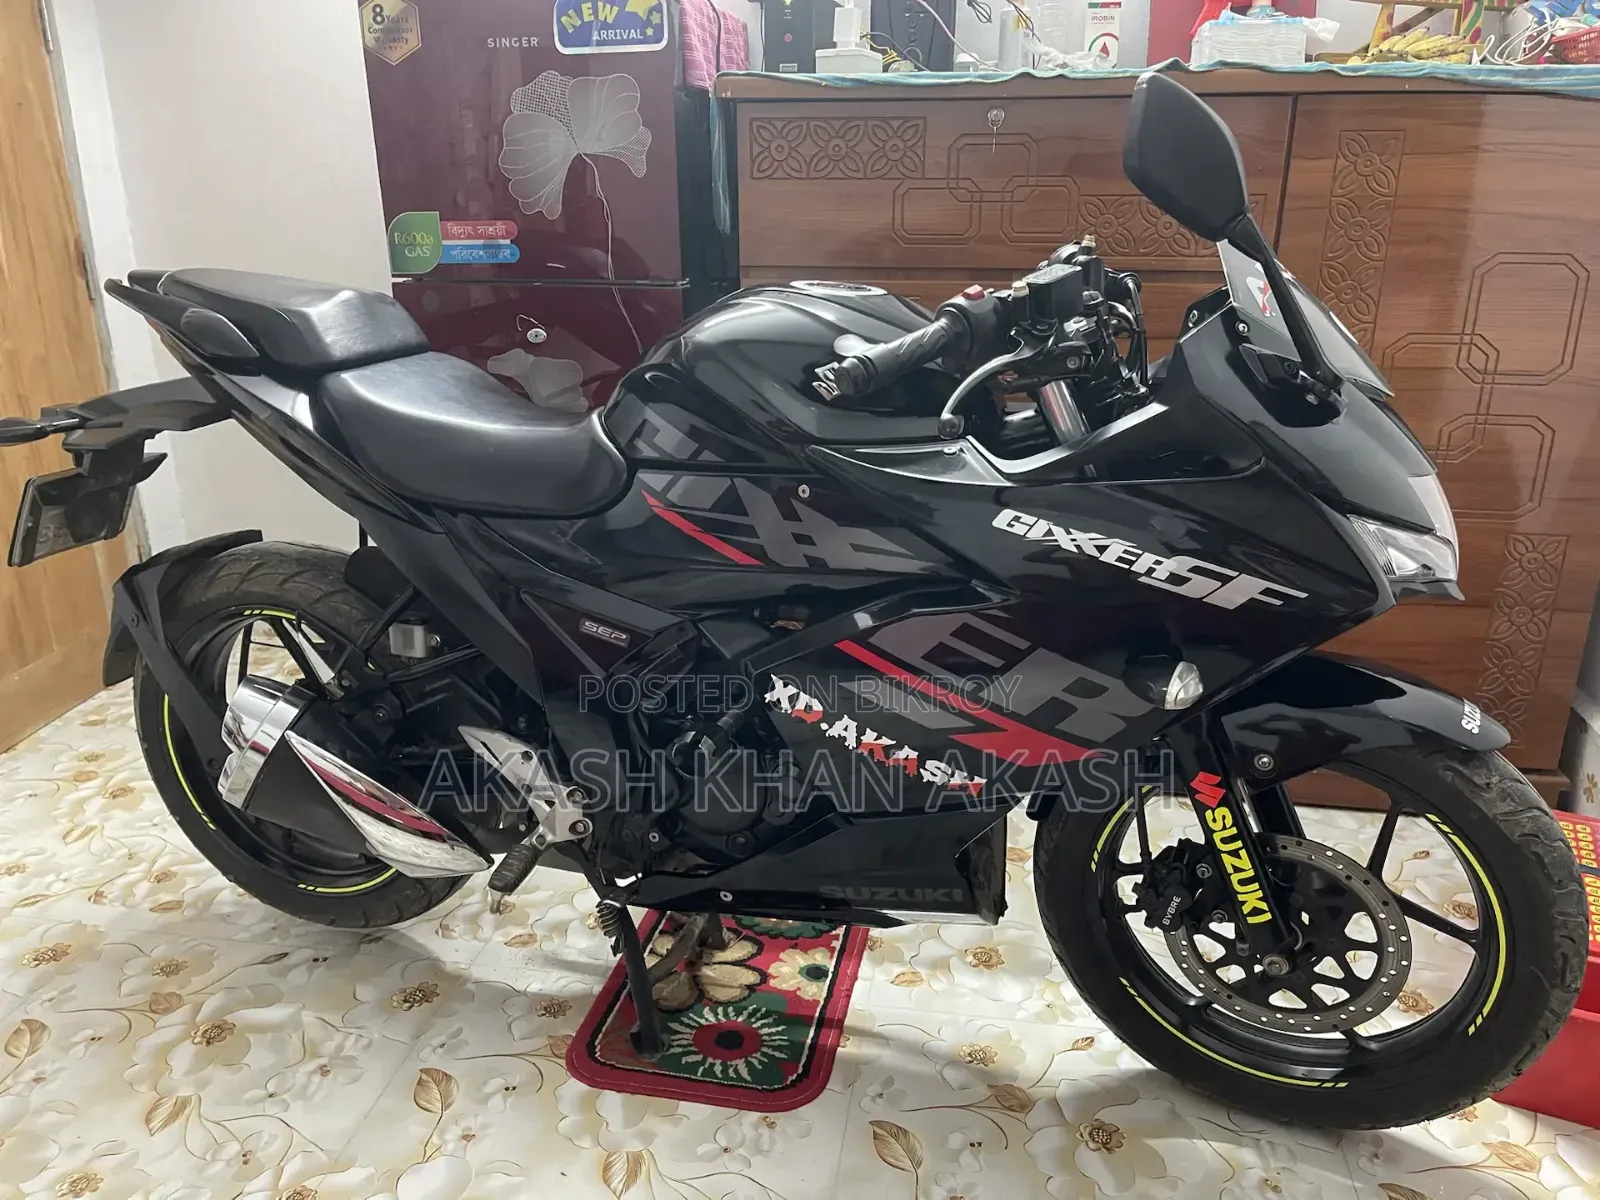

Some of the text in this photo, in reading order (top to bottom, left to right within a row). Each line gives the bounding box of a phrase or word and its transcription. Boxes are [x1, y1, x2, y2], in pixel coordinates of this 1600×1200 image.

[372, 3, 386, 26] 8
[560, 1, 619, 34] NEW
[487, 37, 539, 48] SINGER
[592, 28, 644, 41] ARRIVAL
[394, 232, 434, 245] R600a
[404, 245, 431, 257] GAS
[582, 621, 627, 640] SEP
[1205, 806, 1272, 924] SUZUKI
[818, 885, 963, 901] SUZUKI
[1161, 895, 1182, 926] BYBRE
